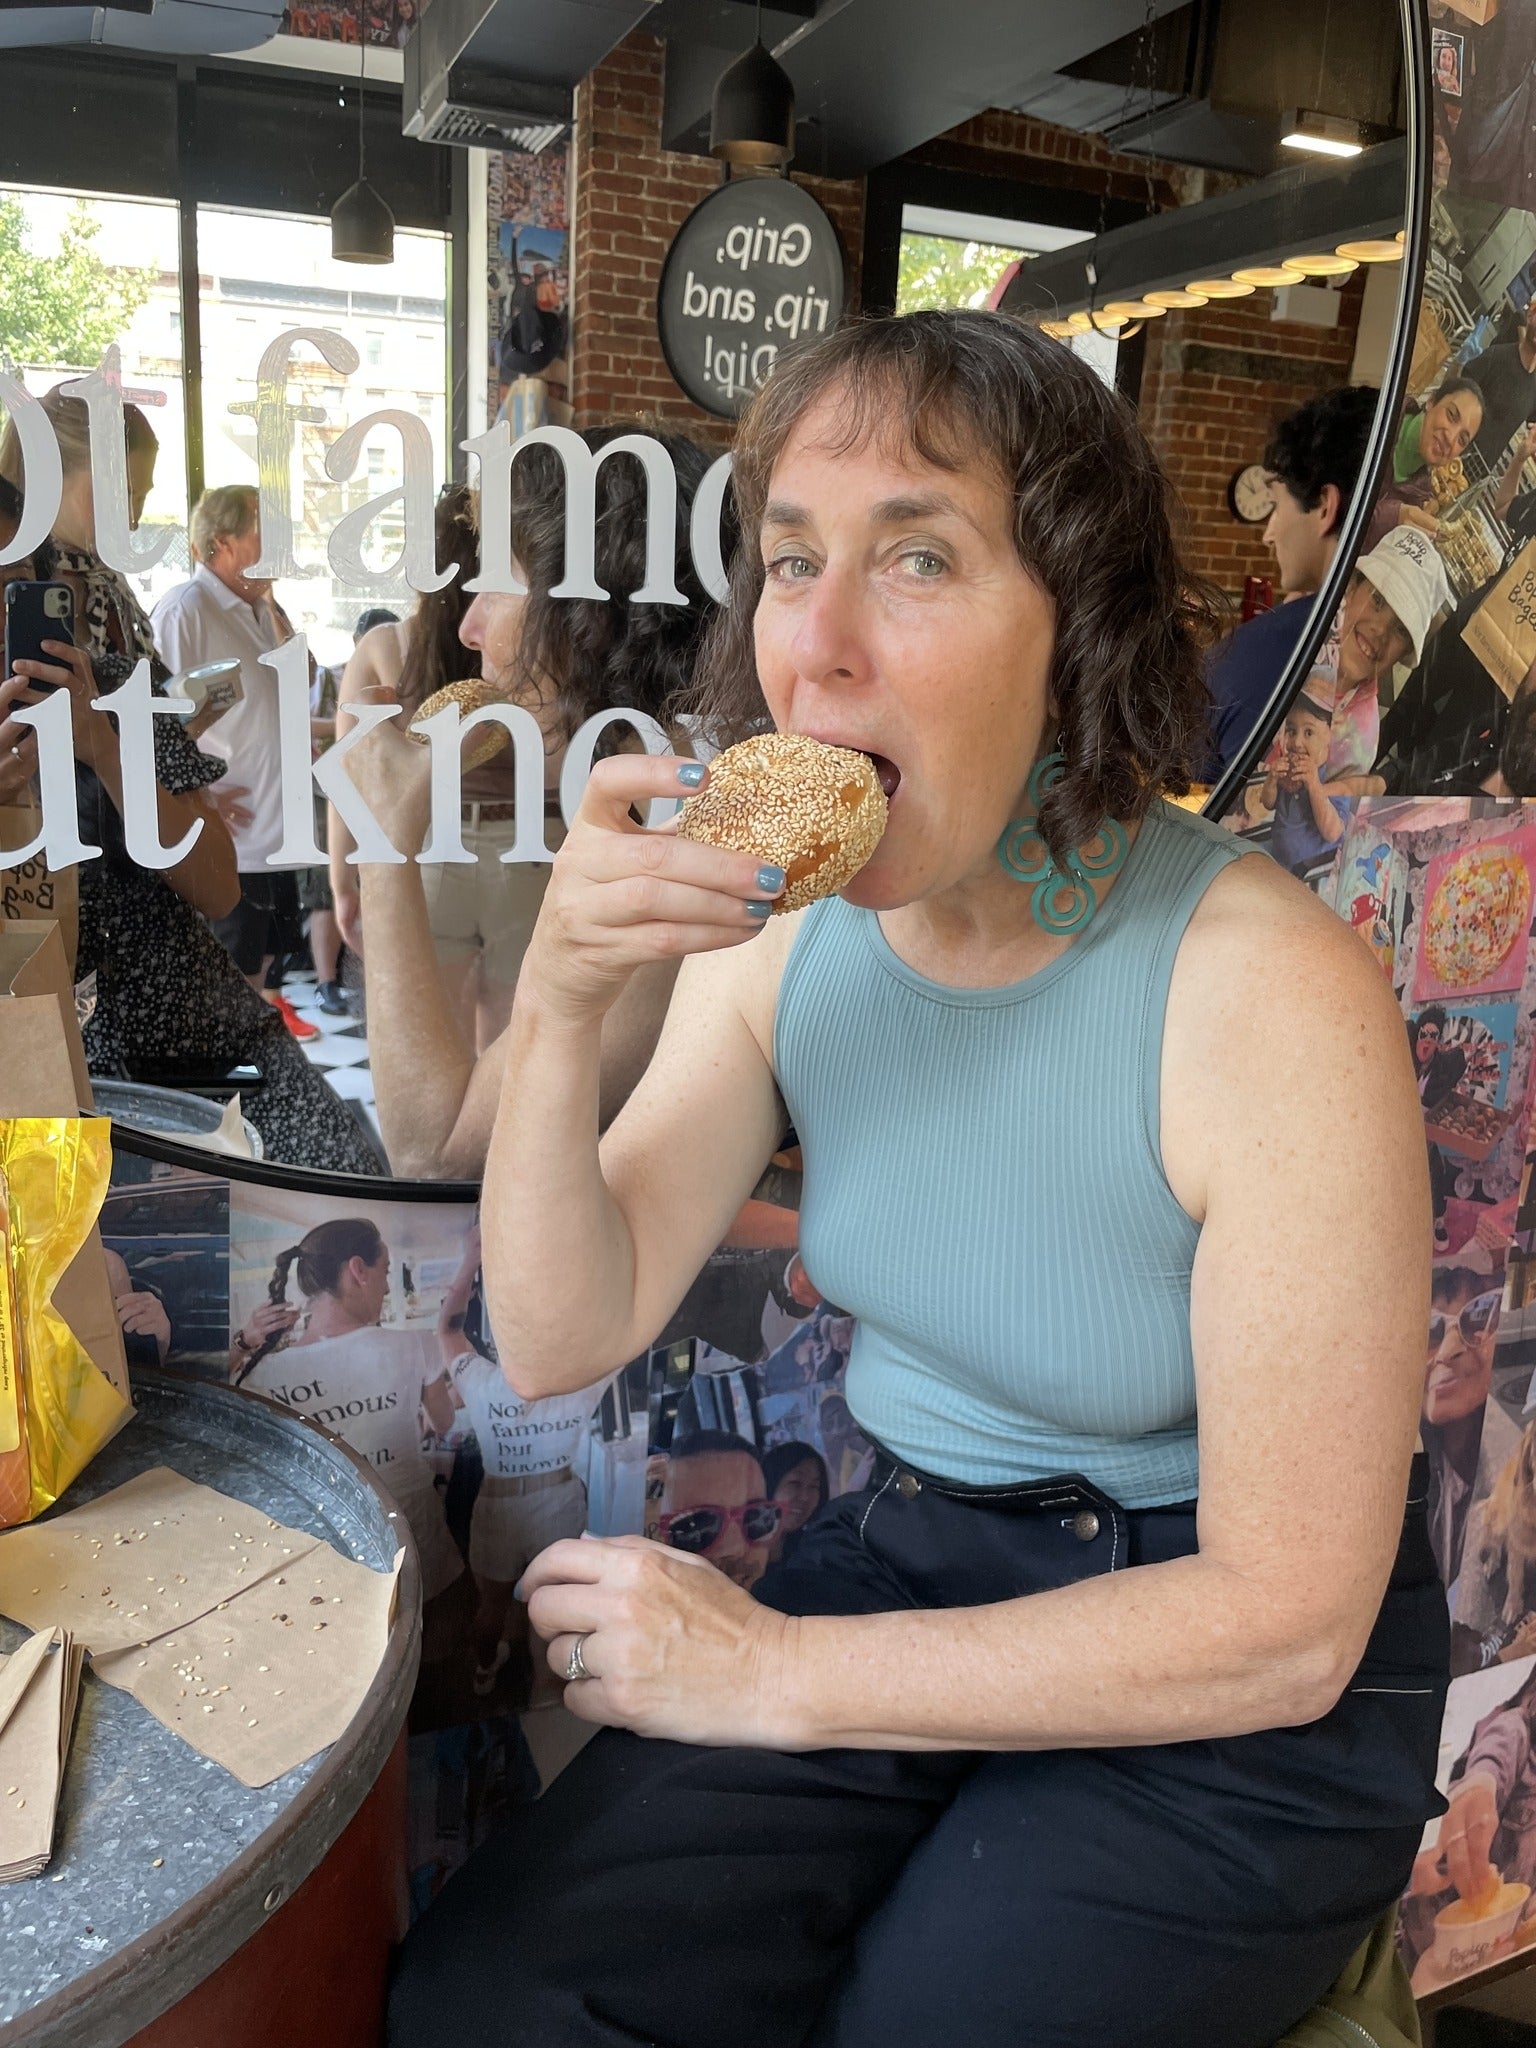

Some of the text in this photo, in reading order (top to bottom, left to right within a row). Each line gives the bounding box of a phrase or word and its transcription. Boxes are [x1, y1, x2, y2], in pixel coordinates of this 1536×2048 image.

[269, 1379, 327, 1407] Not
[311, 1391, 398, 1425] mous
[491, 1416, 581, 1438] famous
[498, 1442, 532, 1456] but
